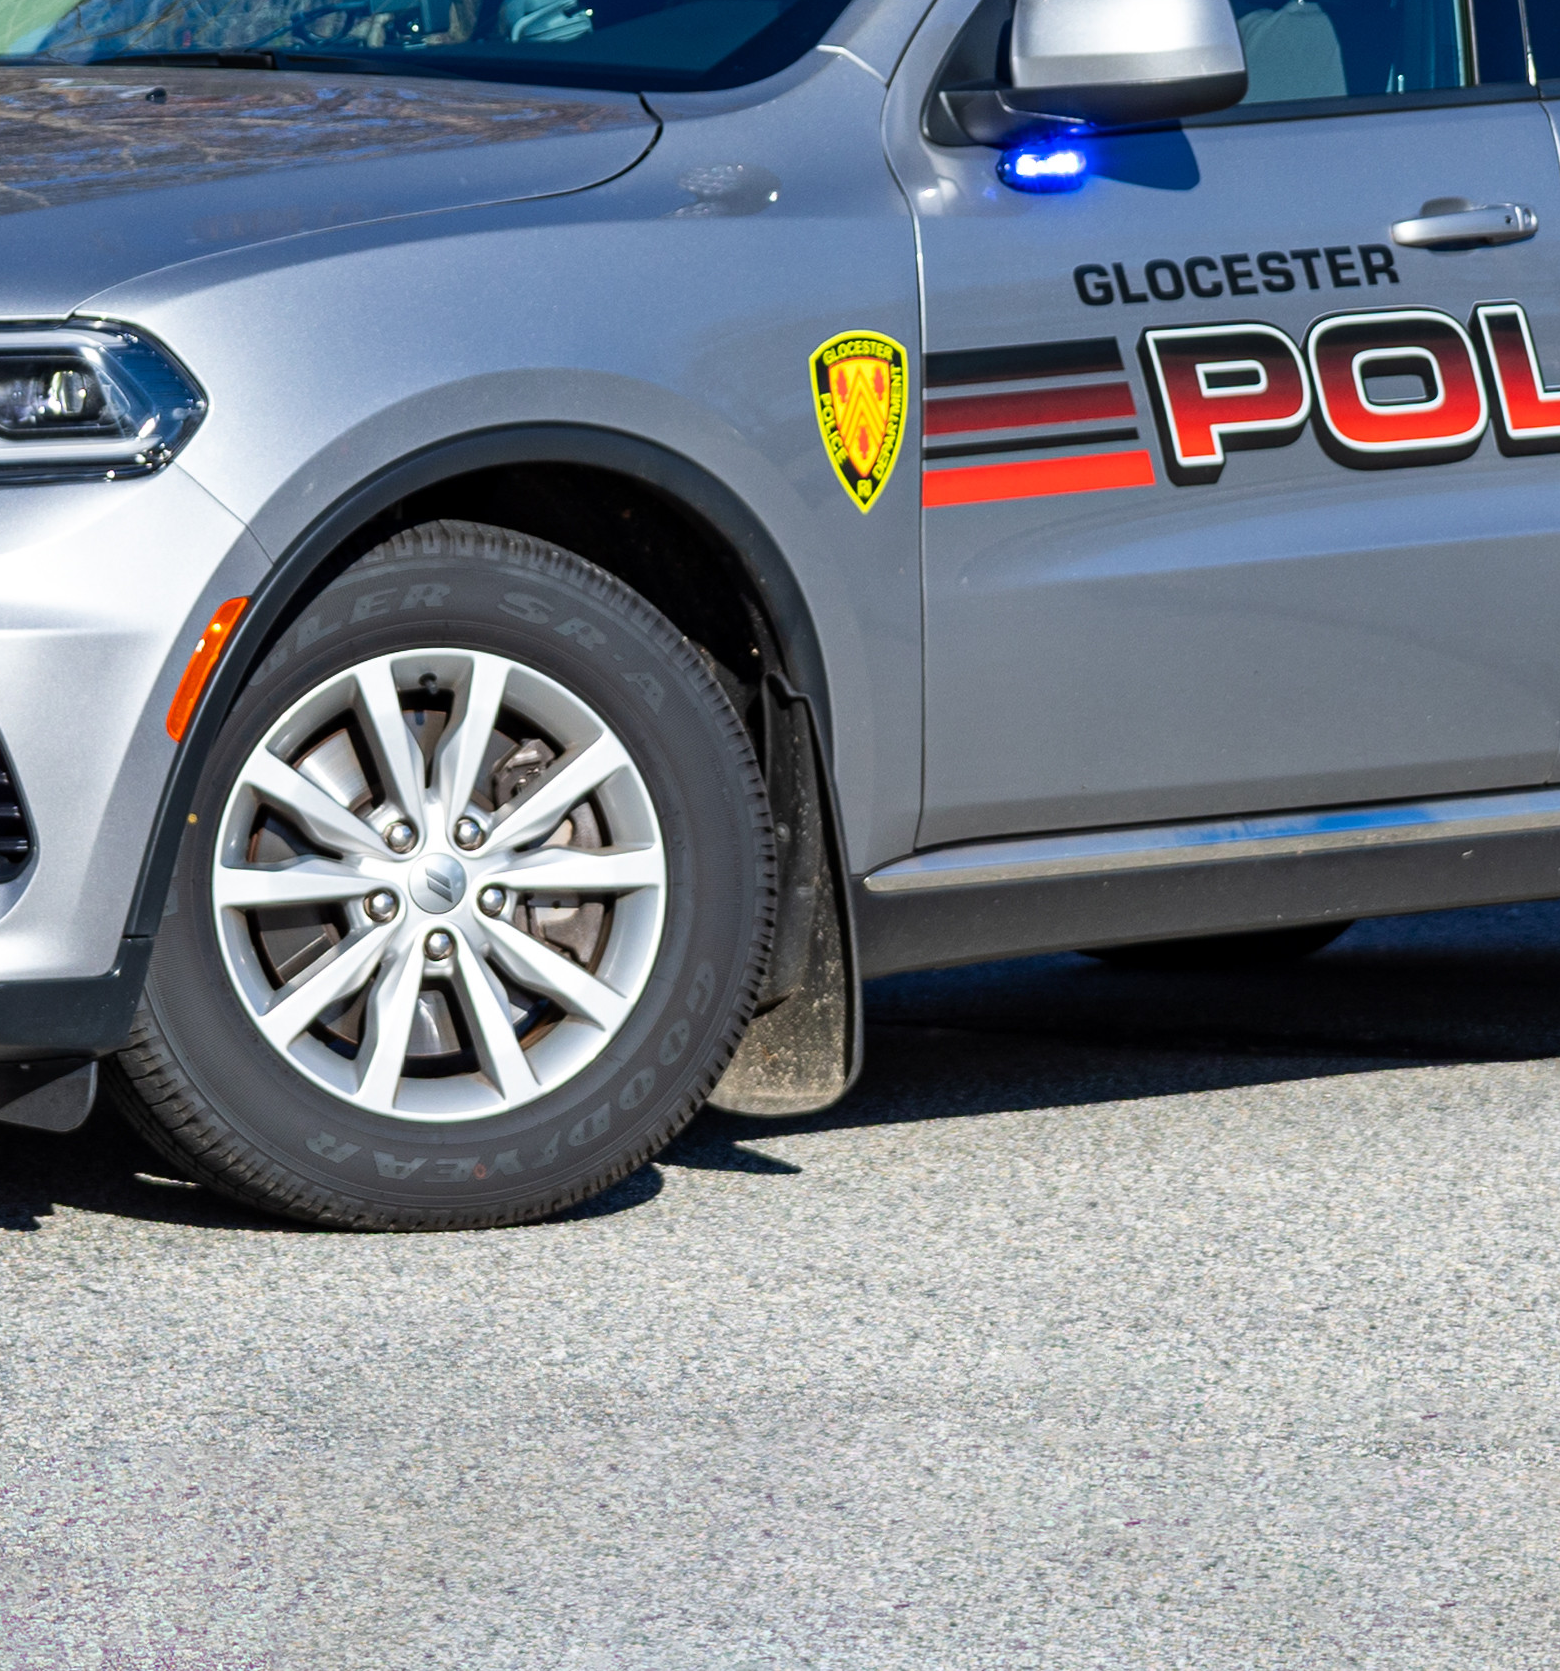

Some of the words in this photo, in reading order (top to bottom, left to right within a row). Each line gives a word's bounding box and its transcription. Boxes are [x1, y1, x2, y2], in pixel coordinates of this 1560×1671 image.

[1073, 243, 1400, 306] GLOCESTER
[823, 340, 894, 367] GLOCESTER
[820, 393, 849, 466] POLICE
[872, 364, 901, 480] DEPARTMENT
[857, 479, 872, 498] RI
